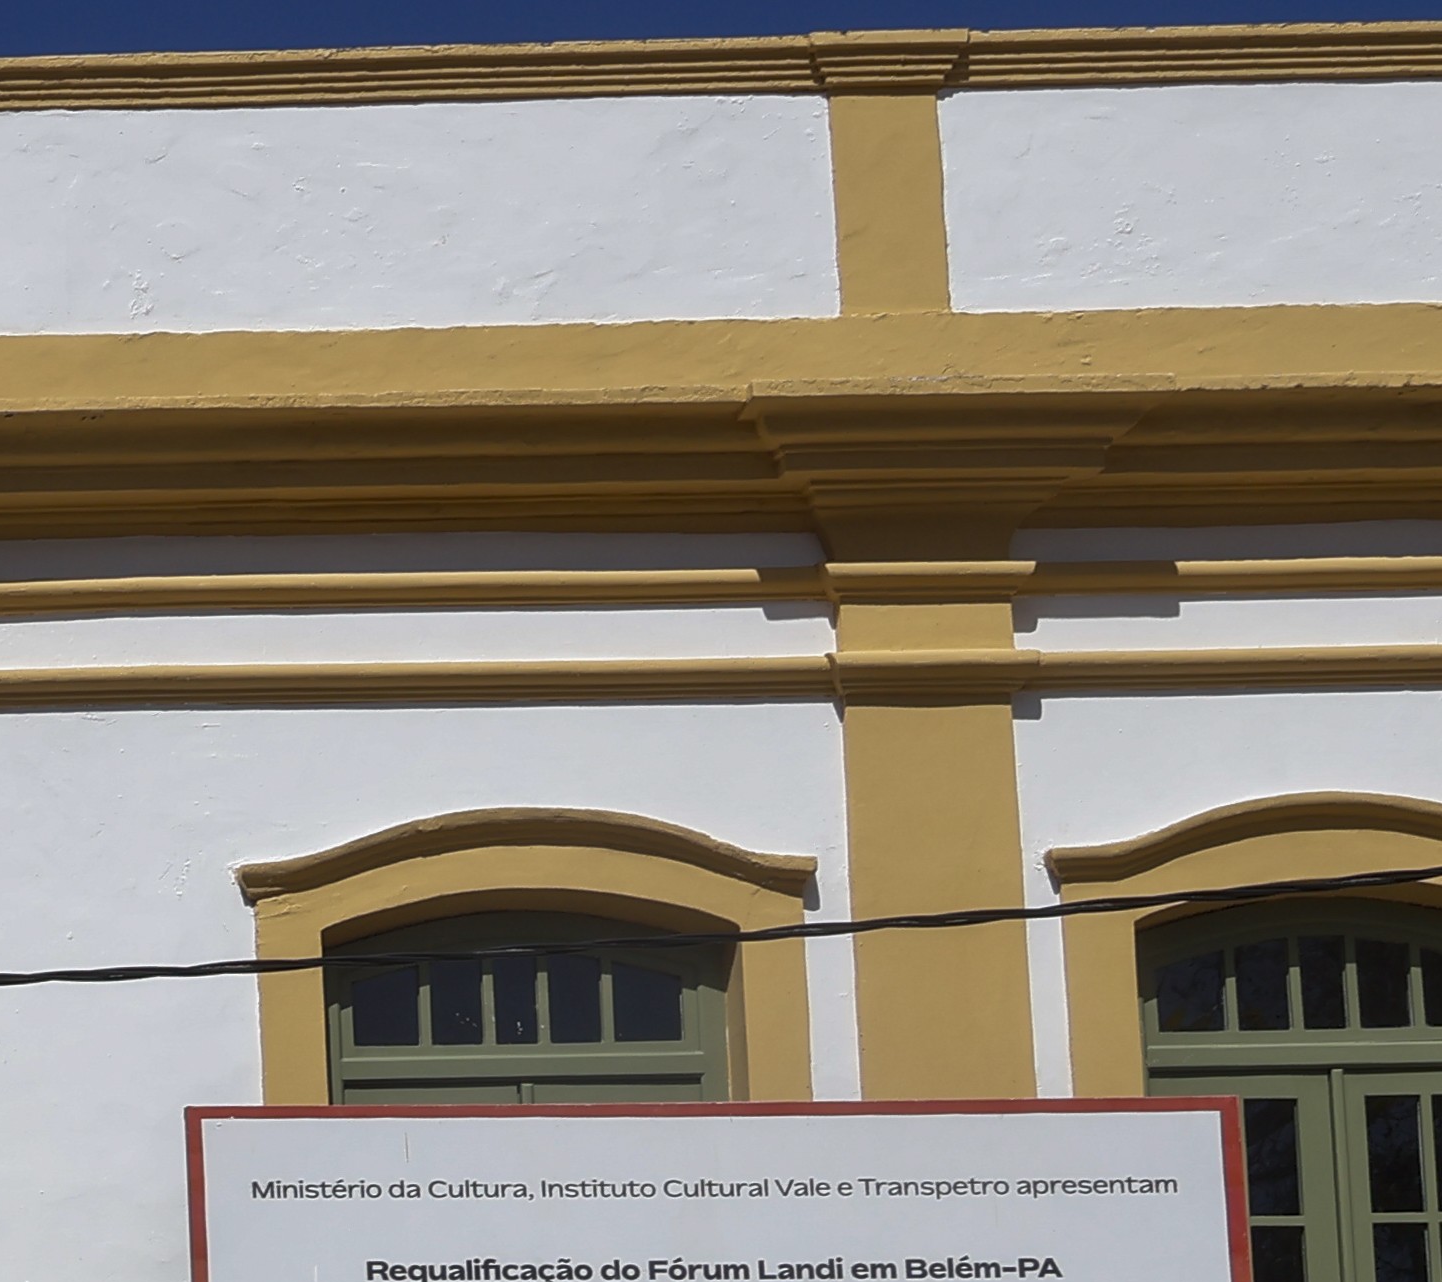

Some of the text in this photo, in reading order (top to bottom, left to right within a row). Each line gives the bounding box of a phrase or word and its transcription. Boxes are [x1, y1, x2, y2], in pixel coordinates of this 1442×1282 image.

[251, 1176, 1178, 1201] Ministério da Cultura, Instituto Cultural Vale e Transpetro apresentam
[600, 1259, 641, 1281] do
[648, 1257, 751, 1281] Fórum
[757, 1256, 844, 1280] Landi
[850, 1262, 898, 1280] em
[904, 1255, 1064, 1280] Belém-PA
